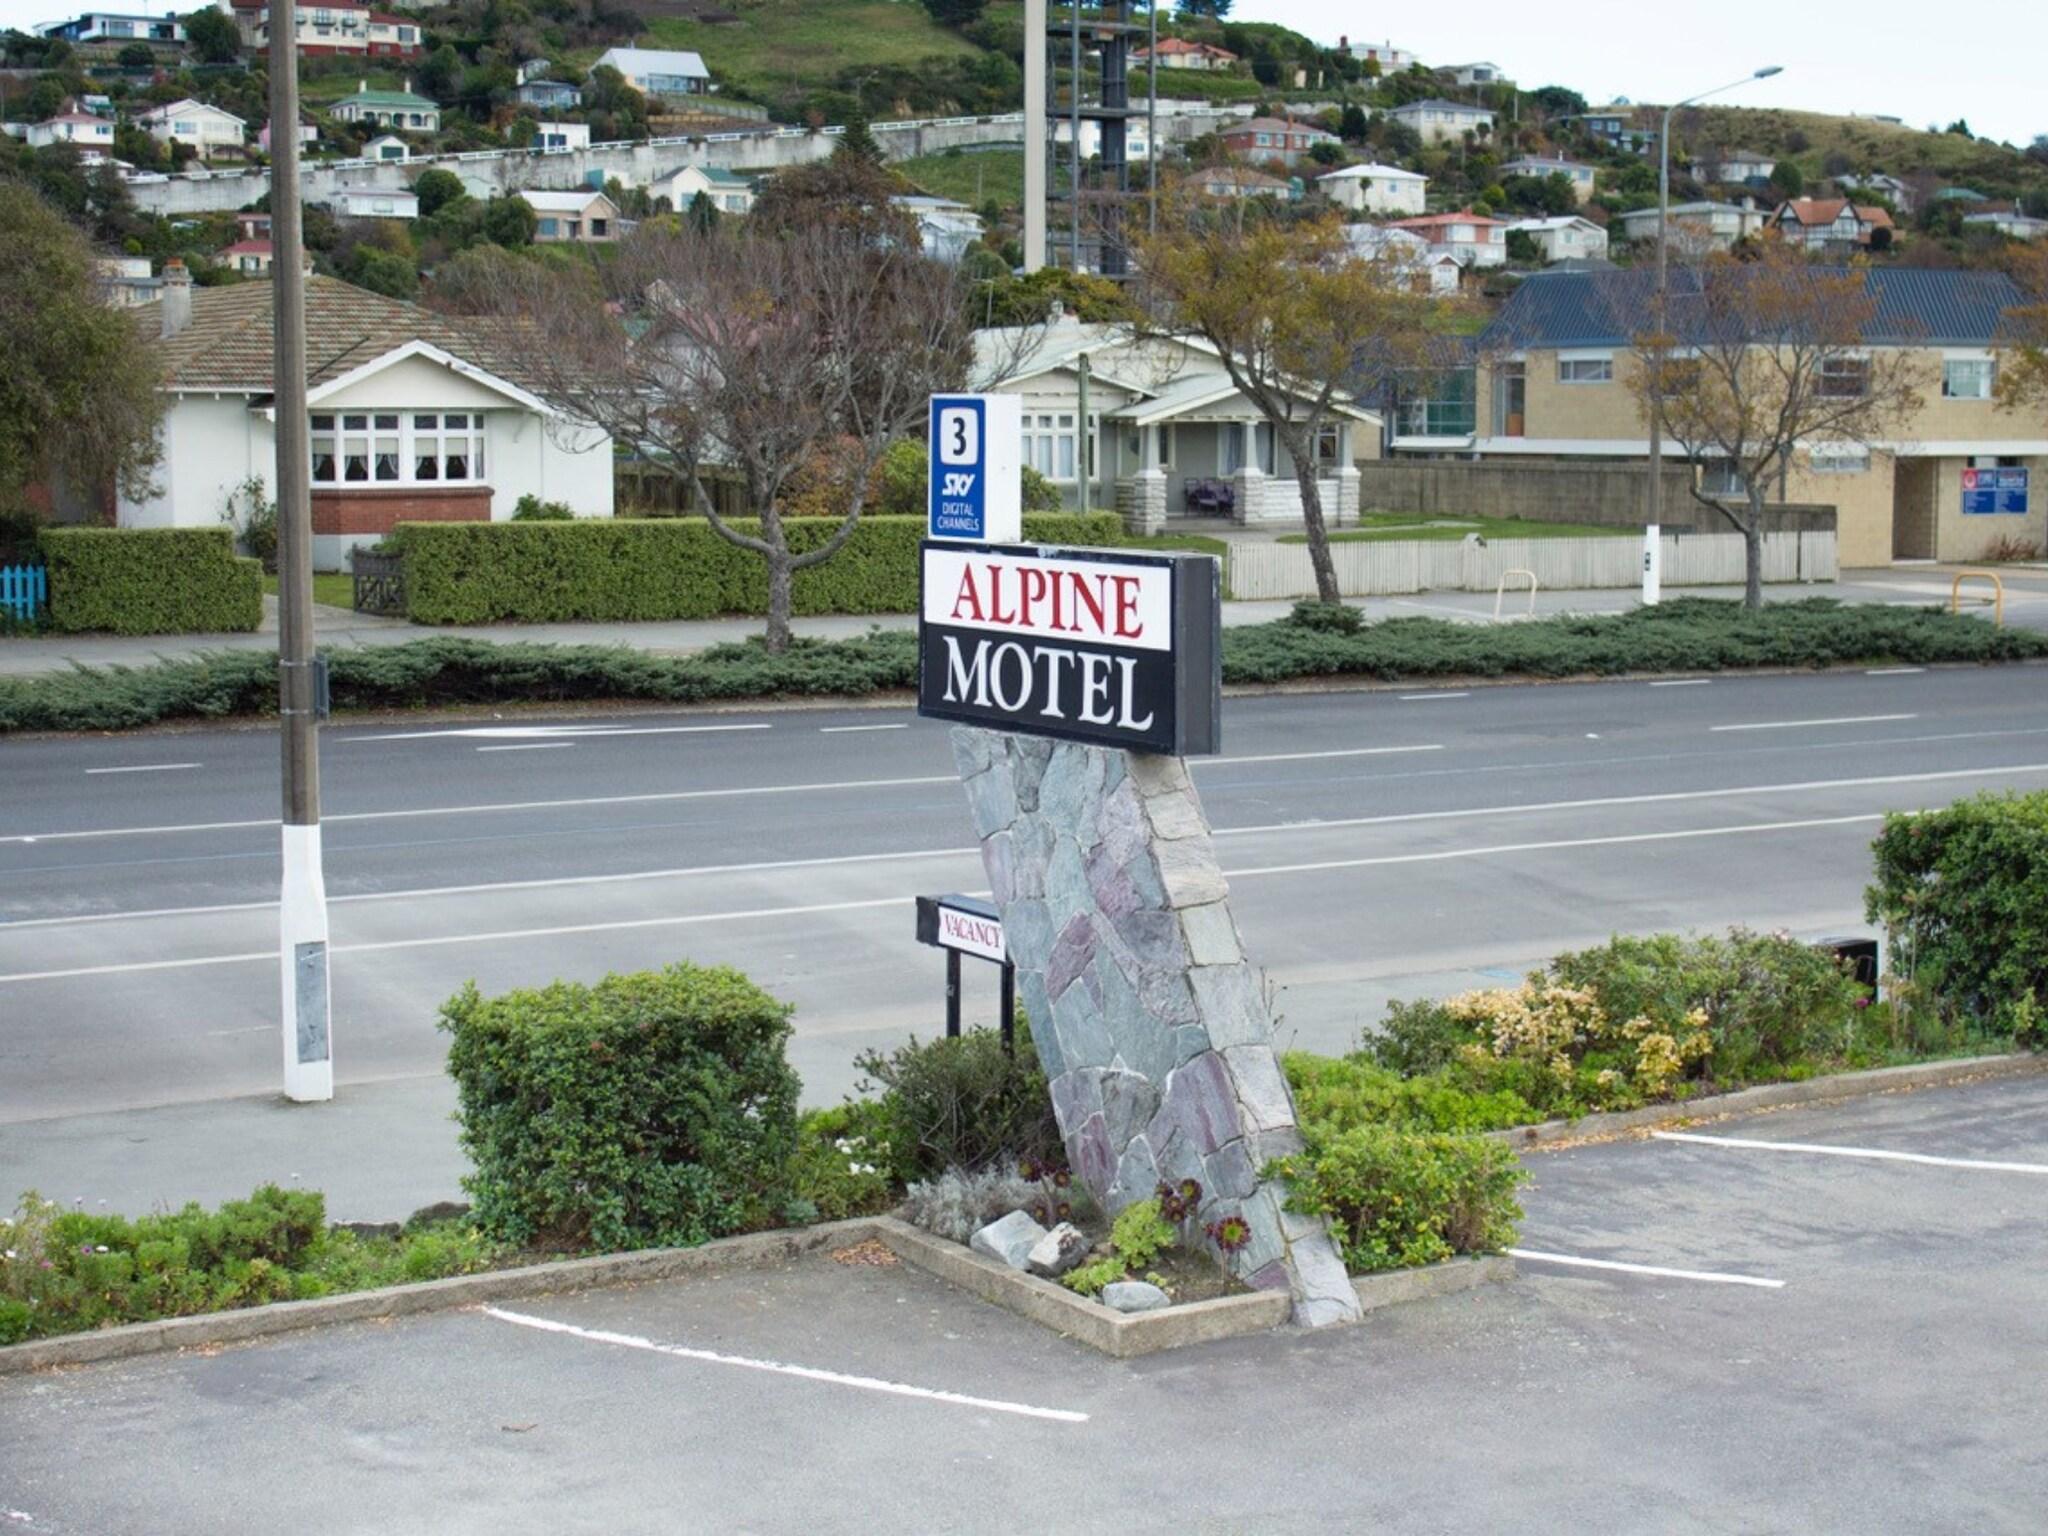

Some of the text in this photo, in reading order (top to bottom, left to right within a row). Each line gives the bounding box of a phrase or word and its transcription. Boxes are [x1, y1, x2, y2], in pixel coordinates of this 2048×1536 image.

[953, 417, 966, 456] 3
[942, 473, 975, 497] SKY
[937, 516, 979, 531] CHANNELS
[942, 502, 974, 516] DIGITAL
[951, 562, 1143, 639] ALPINE
[942, 635, 1154, 731] MOTEL
[944, 914, 1001, 948] VACANCY
